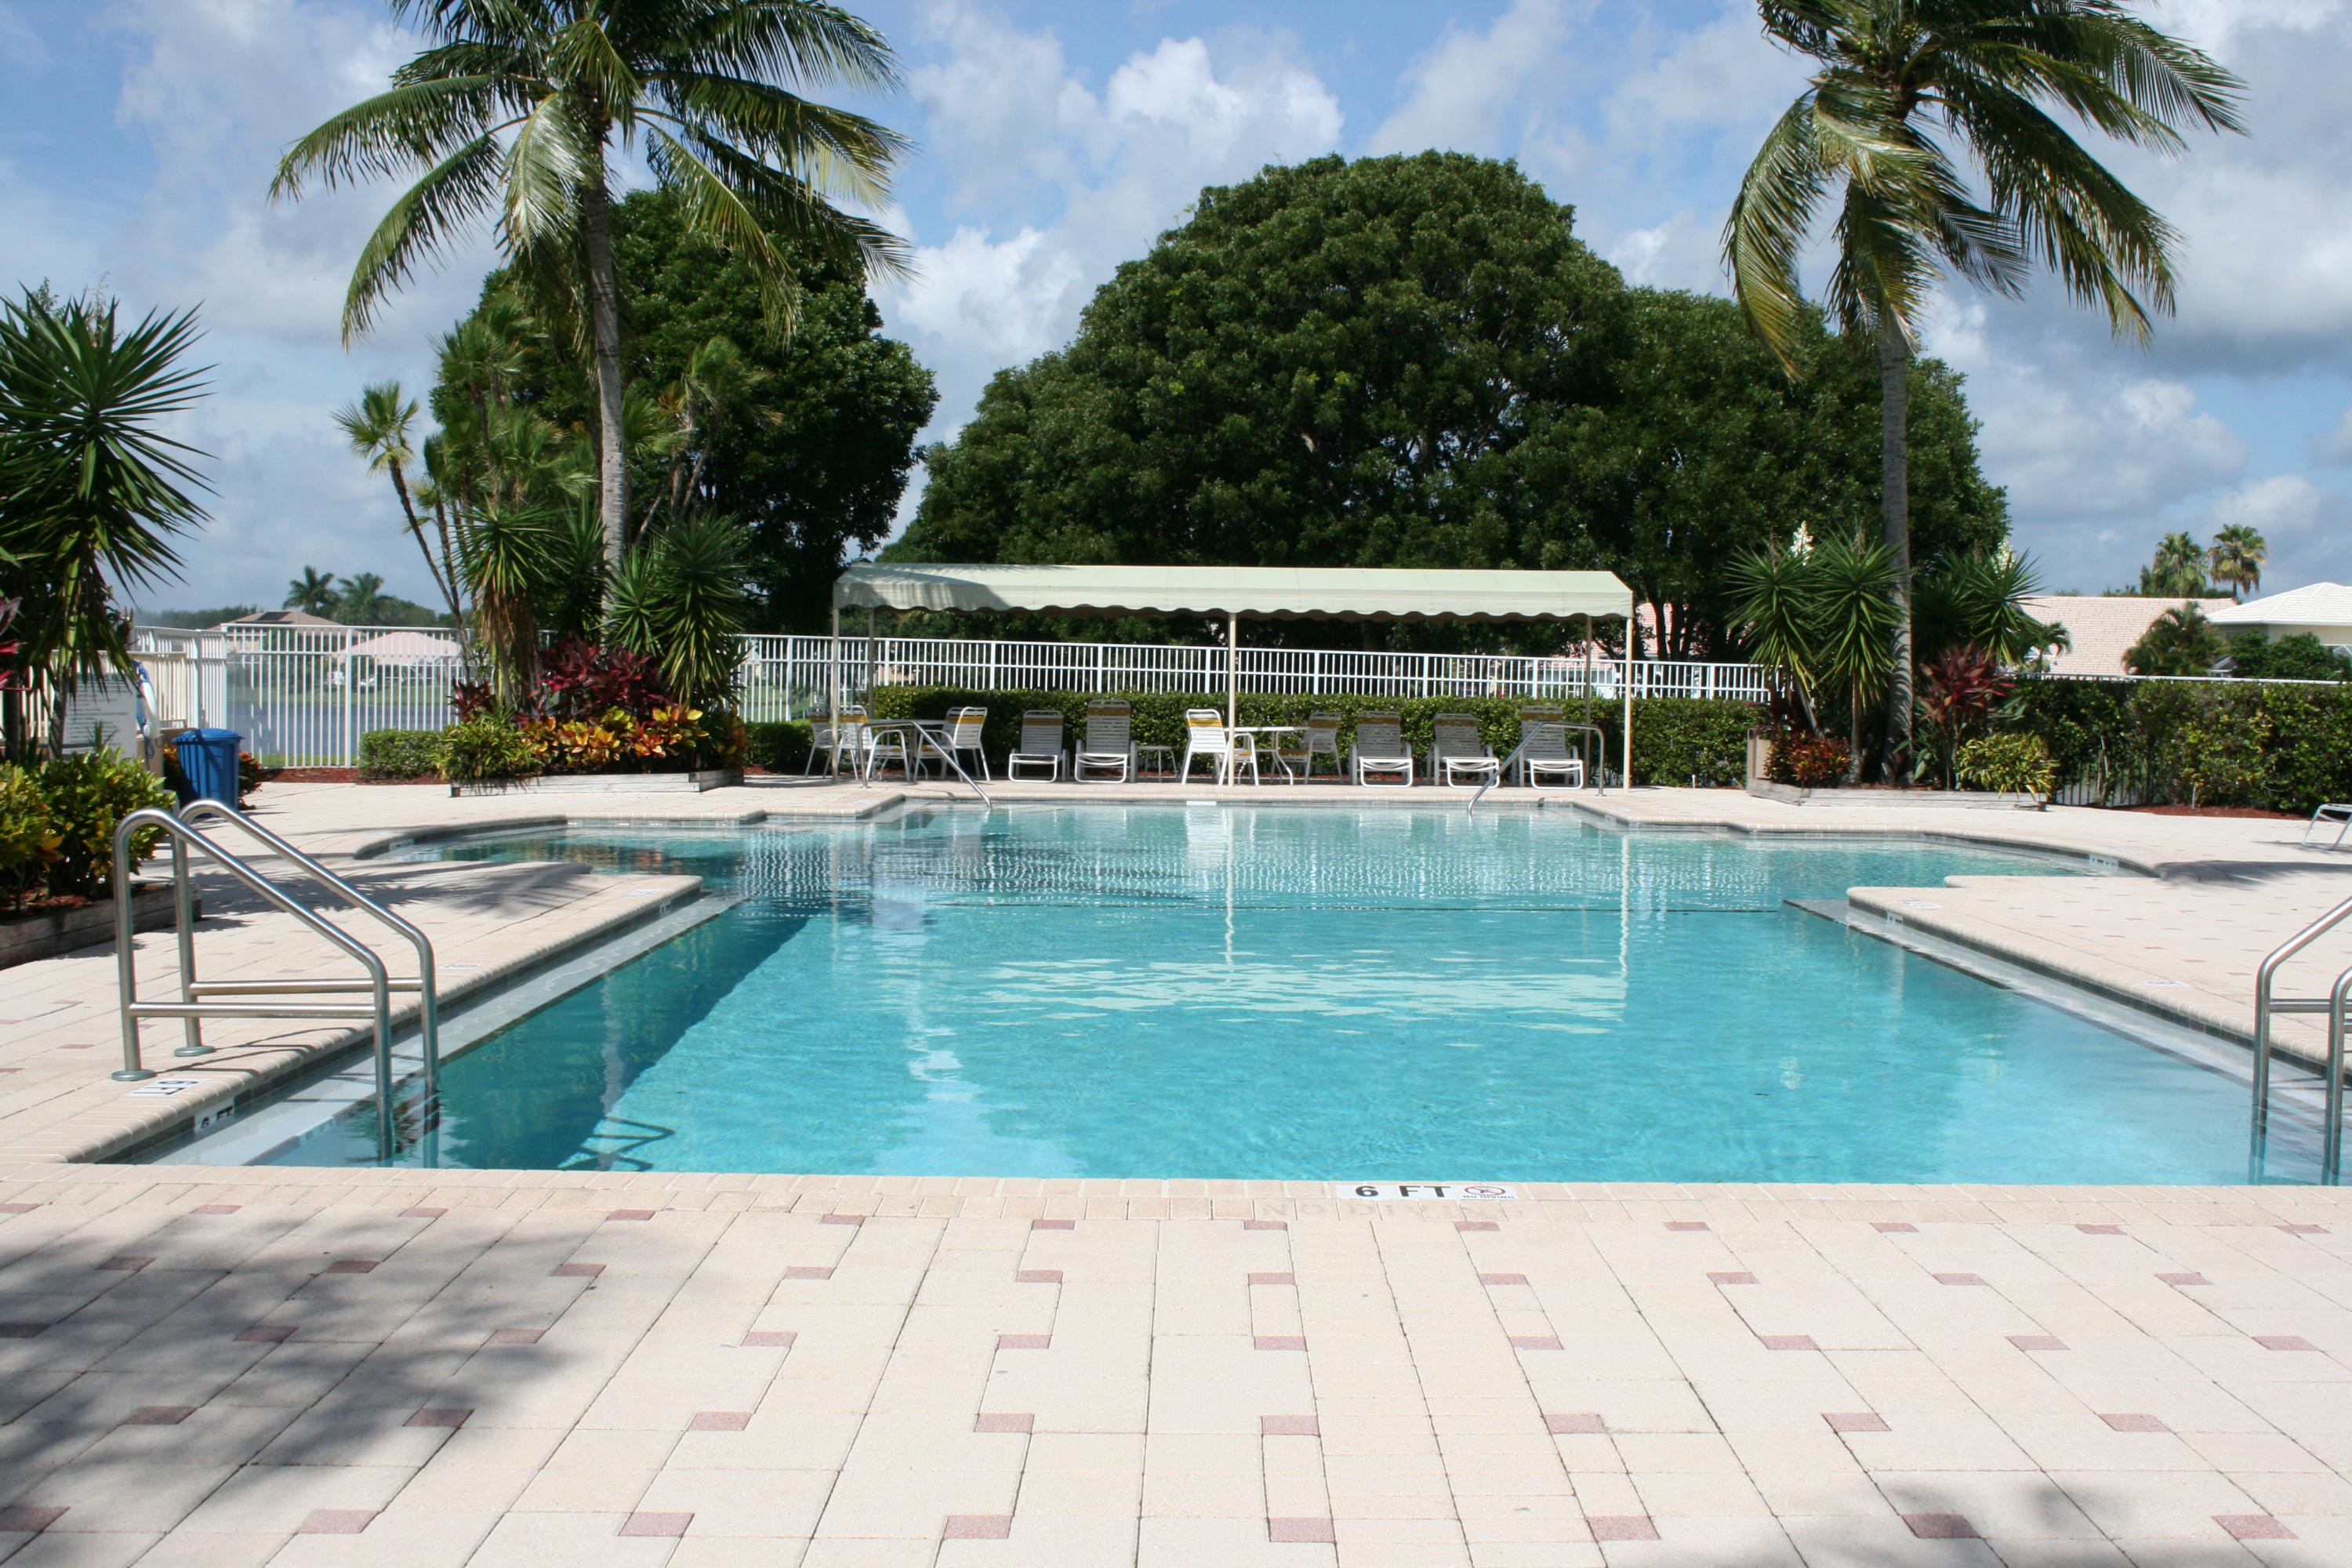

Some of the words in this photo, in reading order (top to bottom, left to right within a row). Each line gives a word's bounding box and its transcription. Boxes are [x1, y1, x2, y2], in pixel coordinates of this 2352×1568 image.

[132, 1087, 187, 1095] FT
[201, 1116, 210, 1129] 6
[216, 1105, 234, 1121] FT
[1355, 1185, 1379, 1197] 6
[1399, 1185, 1451, 1198] FT
